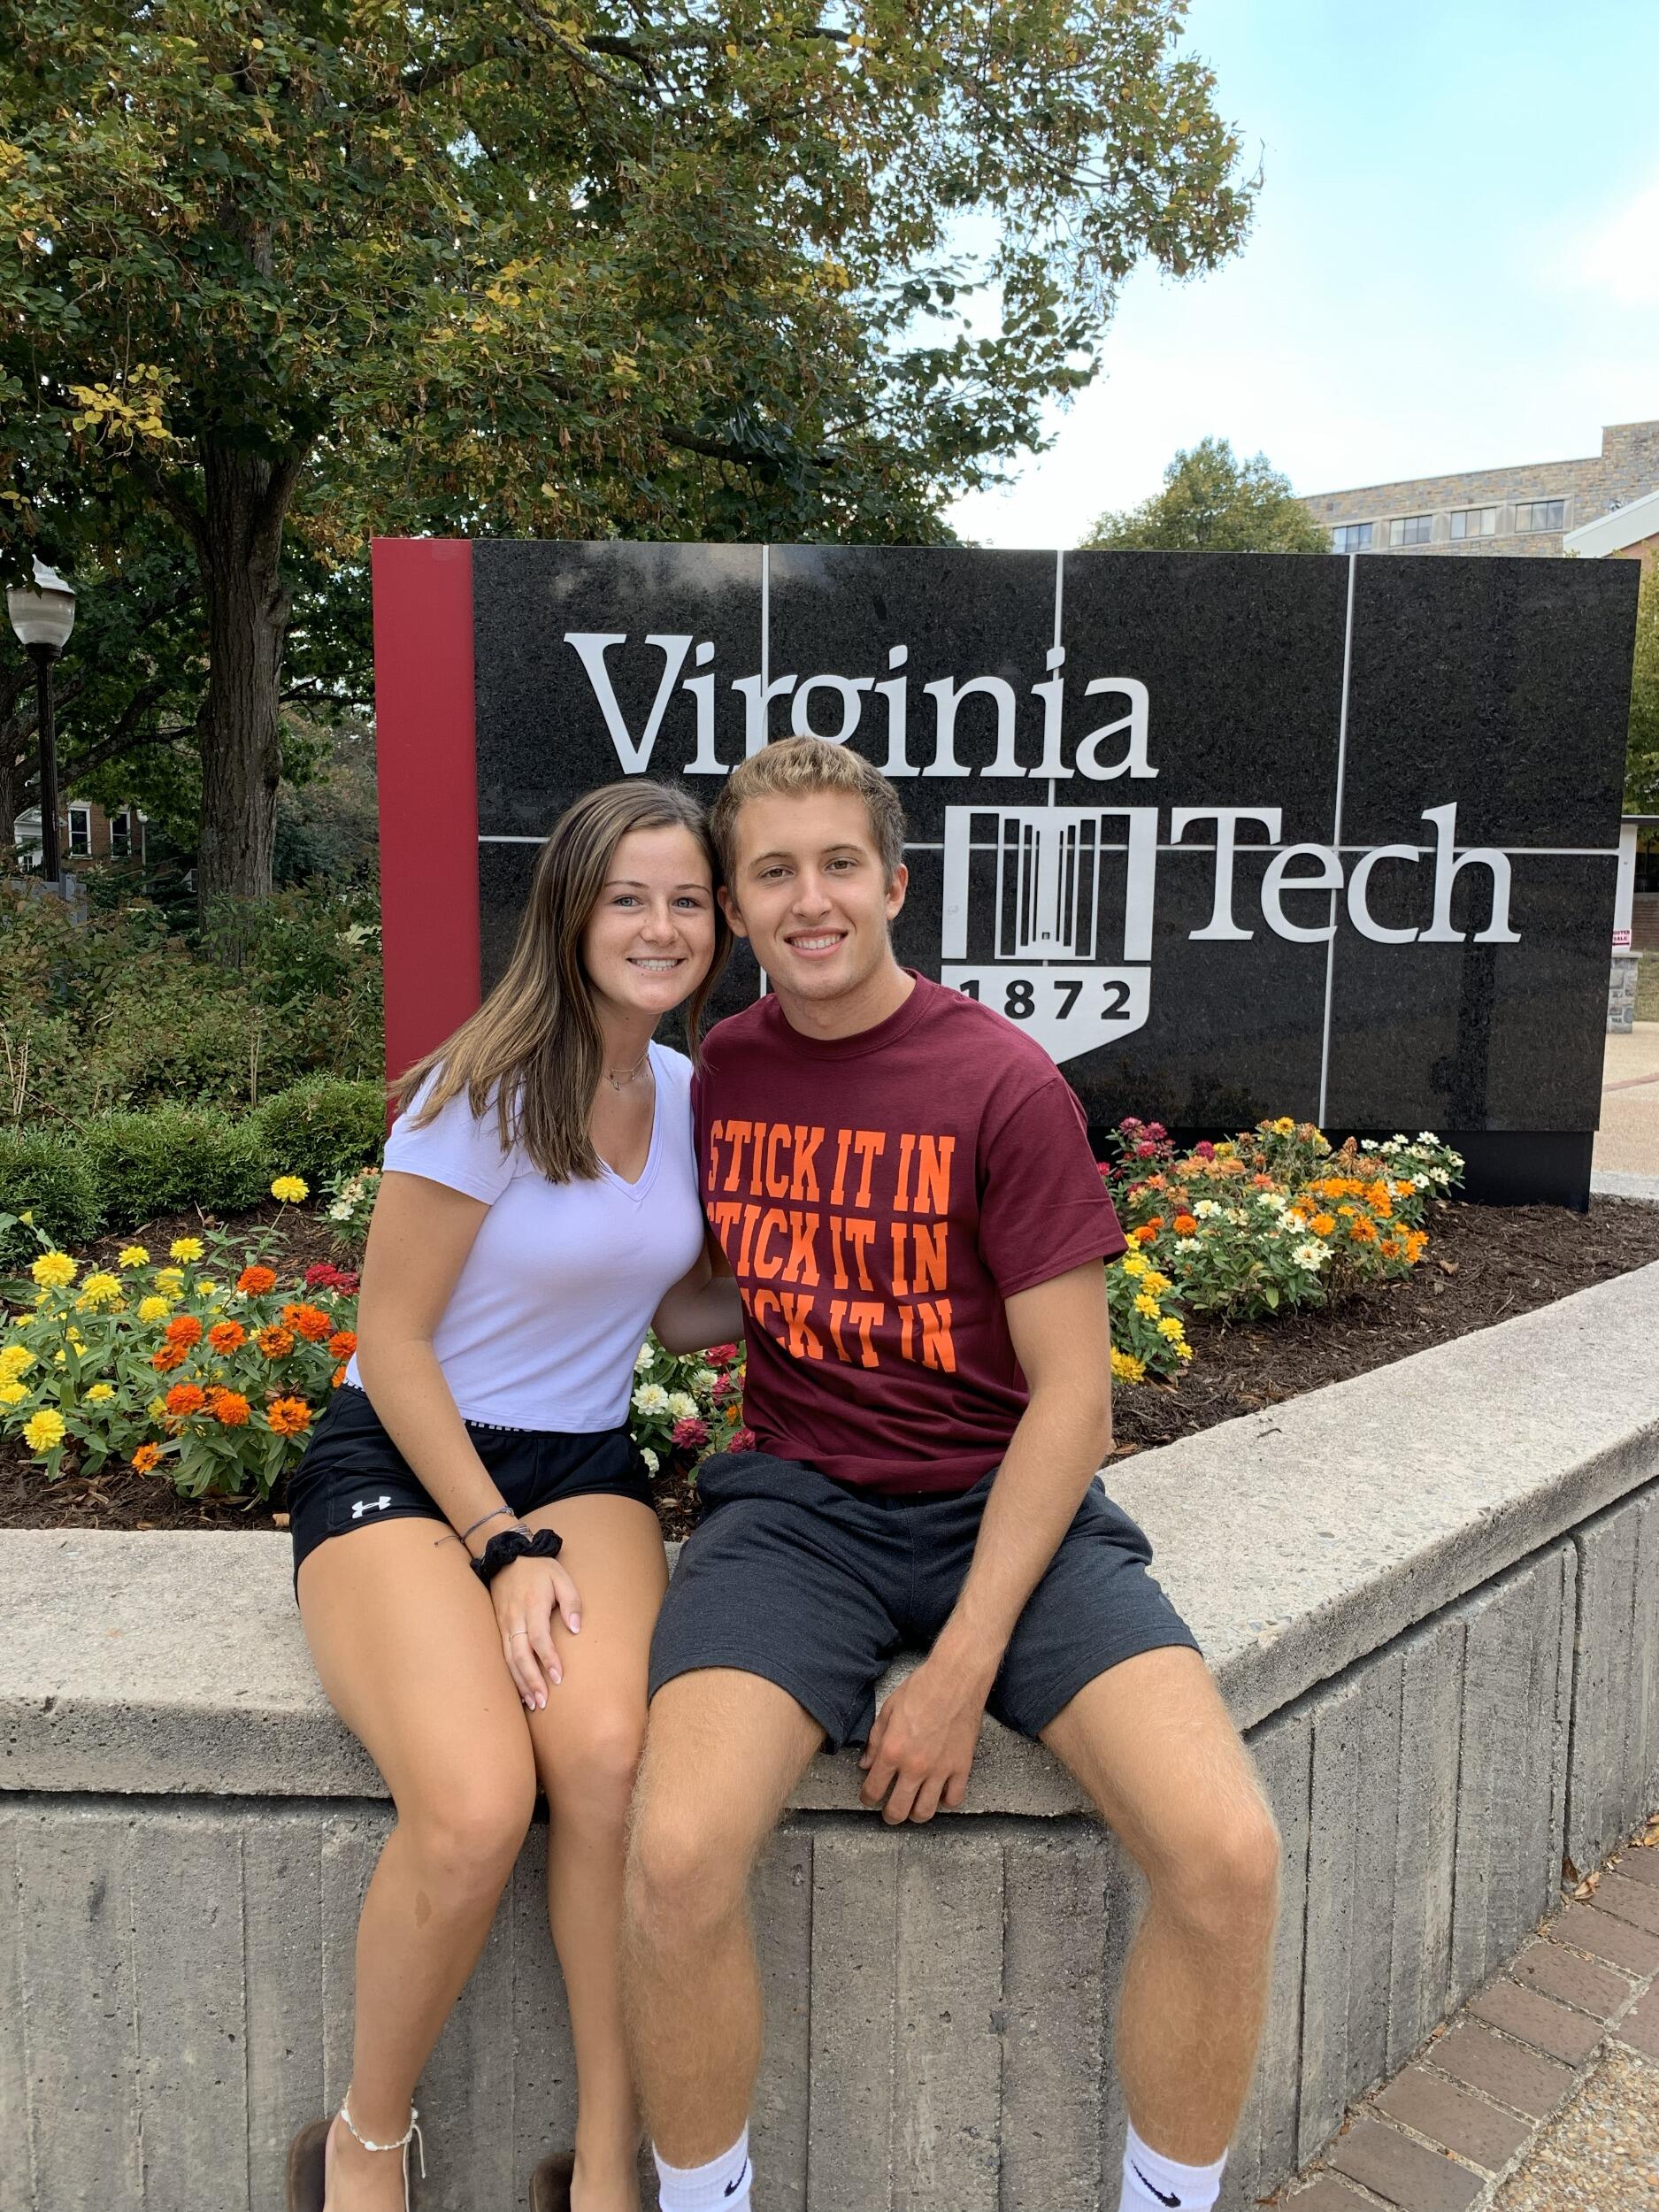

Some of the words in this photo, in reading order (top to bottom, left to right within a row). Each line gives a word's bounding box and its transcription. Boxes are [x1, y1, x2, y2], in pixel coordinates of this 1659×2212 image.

[1170, 802, 1522, 944] Tech
[958, 979, 1131, 1019] 1872
[709, 1119, 825, 1202] STICK
[831, 1129, 886, 1209] IT
[894, 1133, 956, 1216] IN
[707, 1202, 819, 1287] TICK
[830, 1216, 876, 1291] IT
[891, 1221, 949, 1297] IN
[829, 1300, 885, 1368] IT
[898, 1298, 956, 1373] IN
